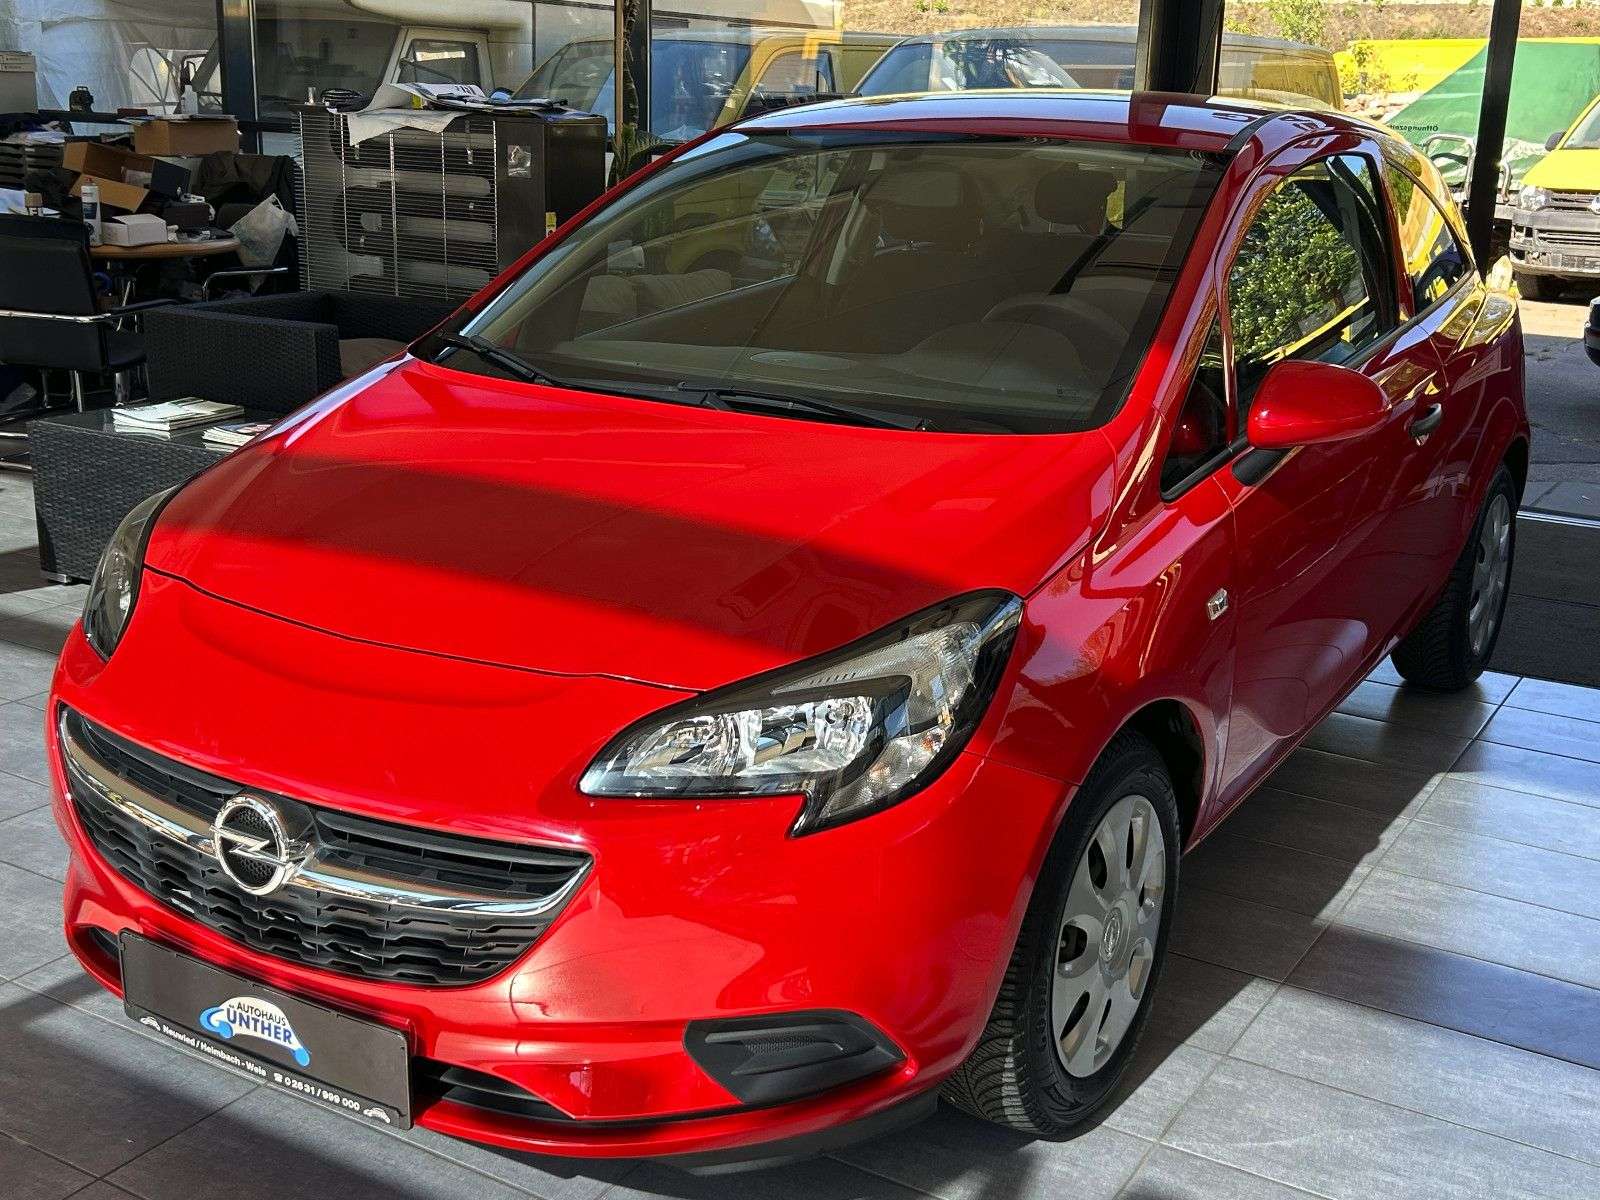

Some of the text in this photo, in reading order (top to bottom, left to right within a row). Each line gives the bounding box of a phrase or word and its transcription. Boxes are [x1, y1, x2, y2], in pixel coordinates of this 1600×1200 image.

[237, 1002, 286, 1027] AUTOHAUS
[162, 1024, 196, 1048] Neuwied
[200, 1041, 241, 1066] Heimbach
[284, 1076, 315, 1096] 02631
[341, 1097, 361, 1112] 000
